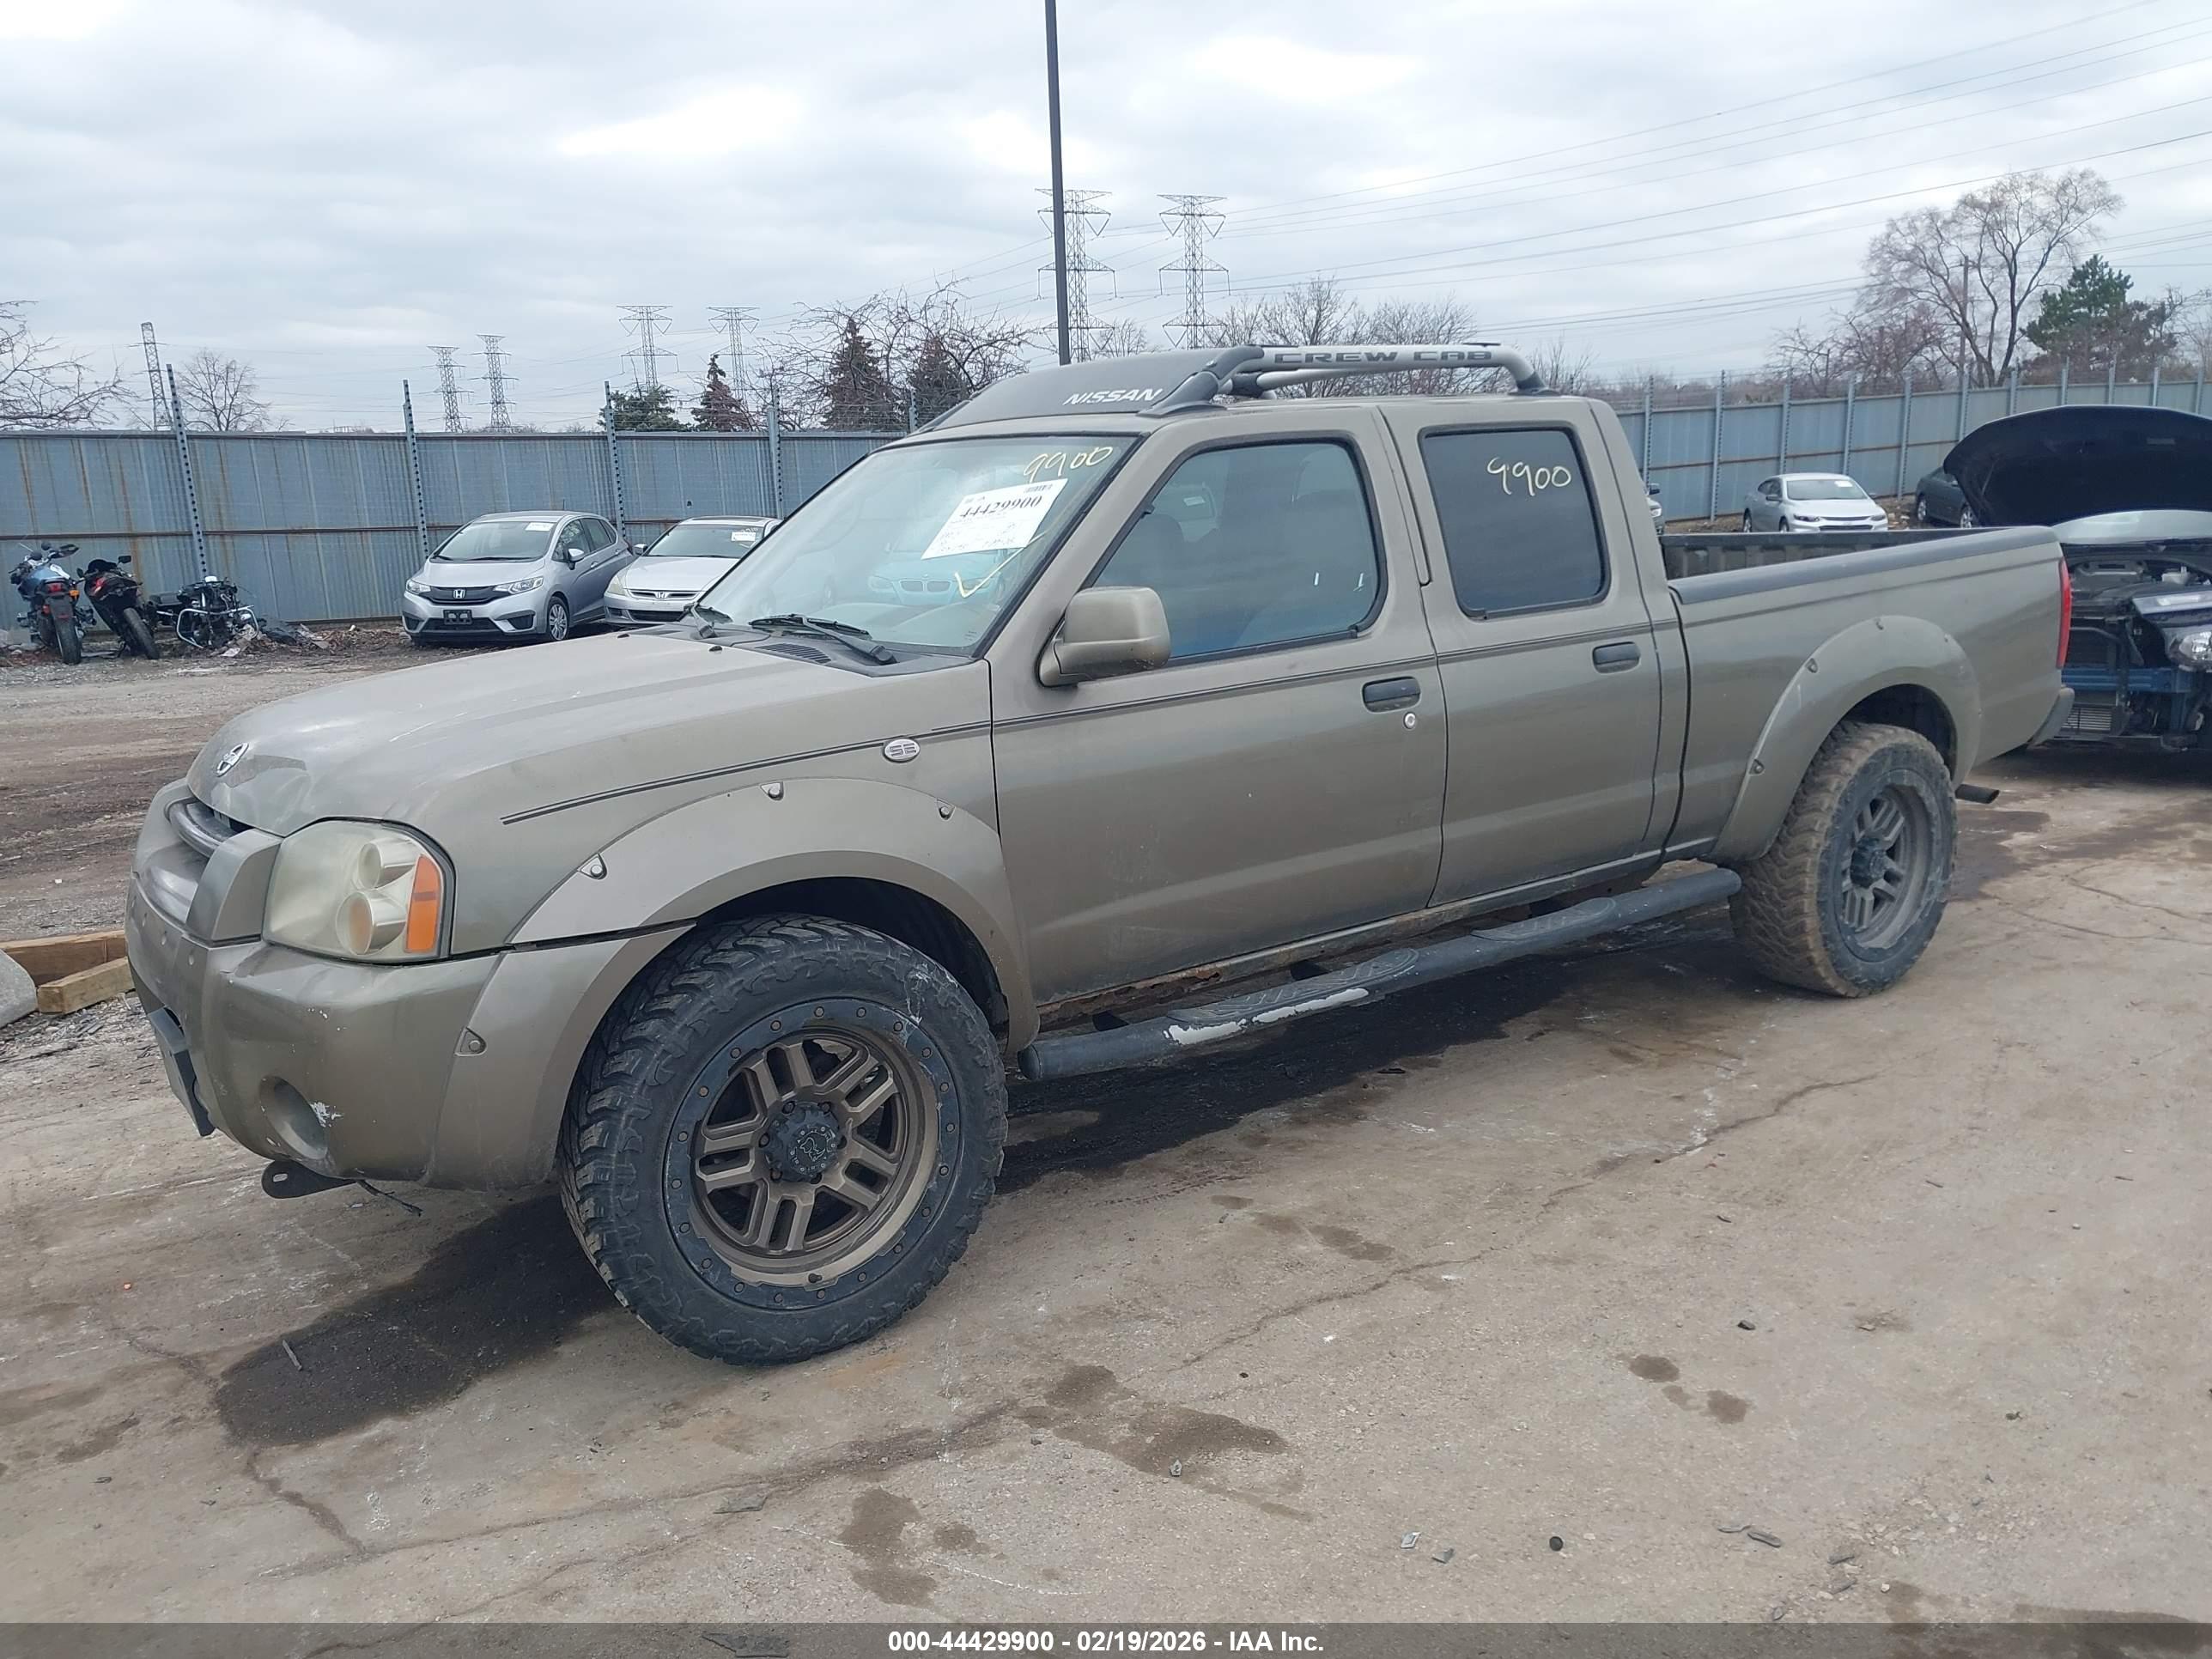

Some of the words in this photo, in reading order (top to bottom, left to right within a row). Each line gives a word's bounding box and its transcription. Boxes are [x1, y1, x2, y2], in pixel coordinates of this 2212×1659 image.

[1274, 351, 1398, 364] CREW
[1413, 350, 1492, 361] CAB
[1062, 388, 1163, 405] NISSAN
[1023, 446, 1114, 483] 9900
[1486, 456, 1571, 496] 9900
[959, 495, 1043, 519] 44429900
